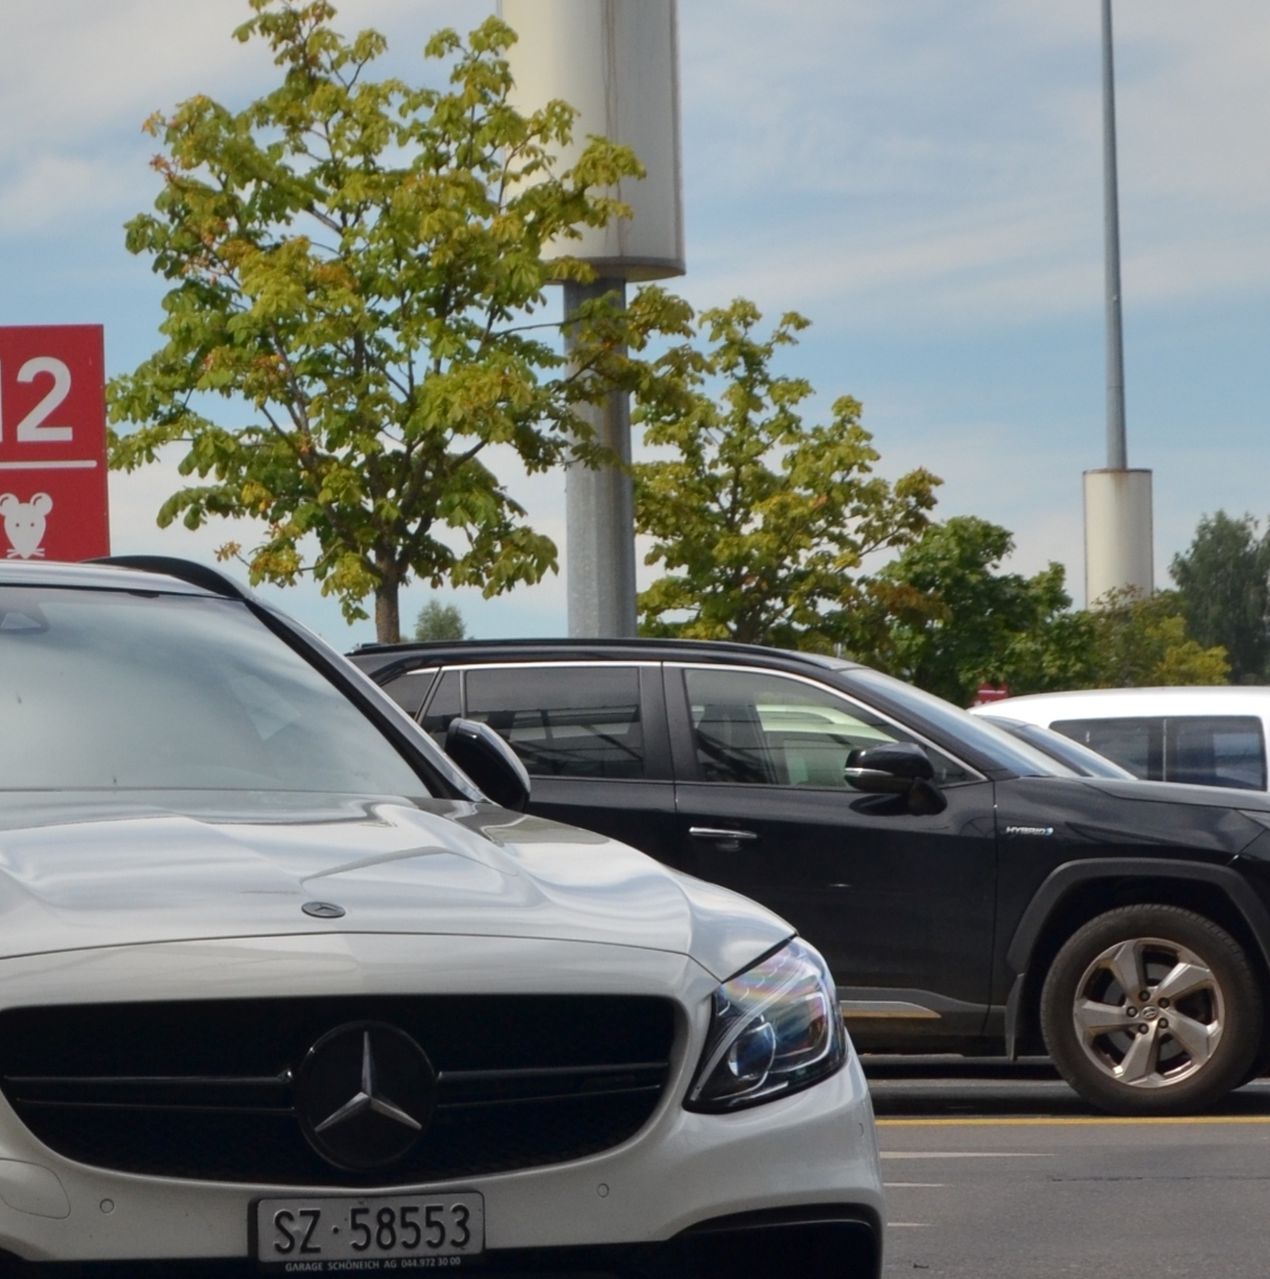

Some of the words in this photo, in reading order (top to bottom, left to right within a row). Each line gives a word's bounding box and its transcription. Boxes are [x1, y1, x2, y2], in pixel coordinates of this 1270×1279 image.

[285, 1262, 323, 1272] GARAGE
[327, 1259, 380, 1271] SCHÖNEICH
[383, 1259, 397, 1269] AG
[437, 1256, 449, 1267] 30
[449, 1256, 461, 1266] 00
